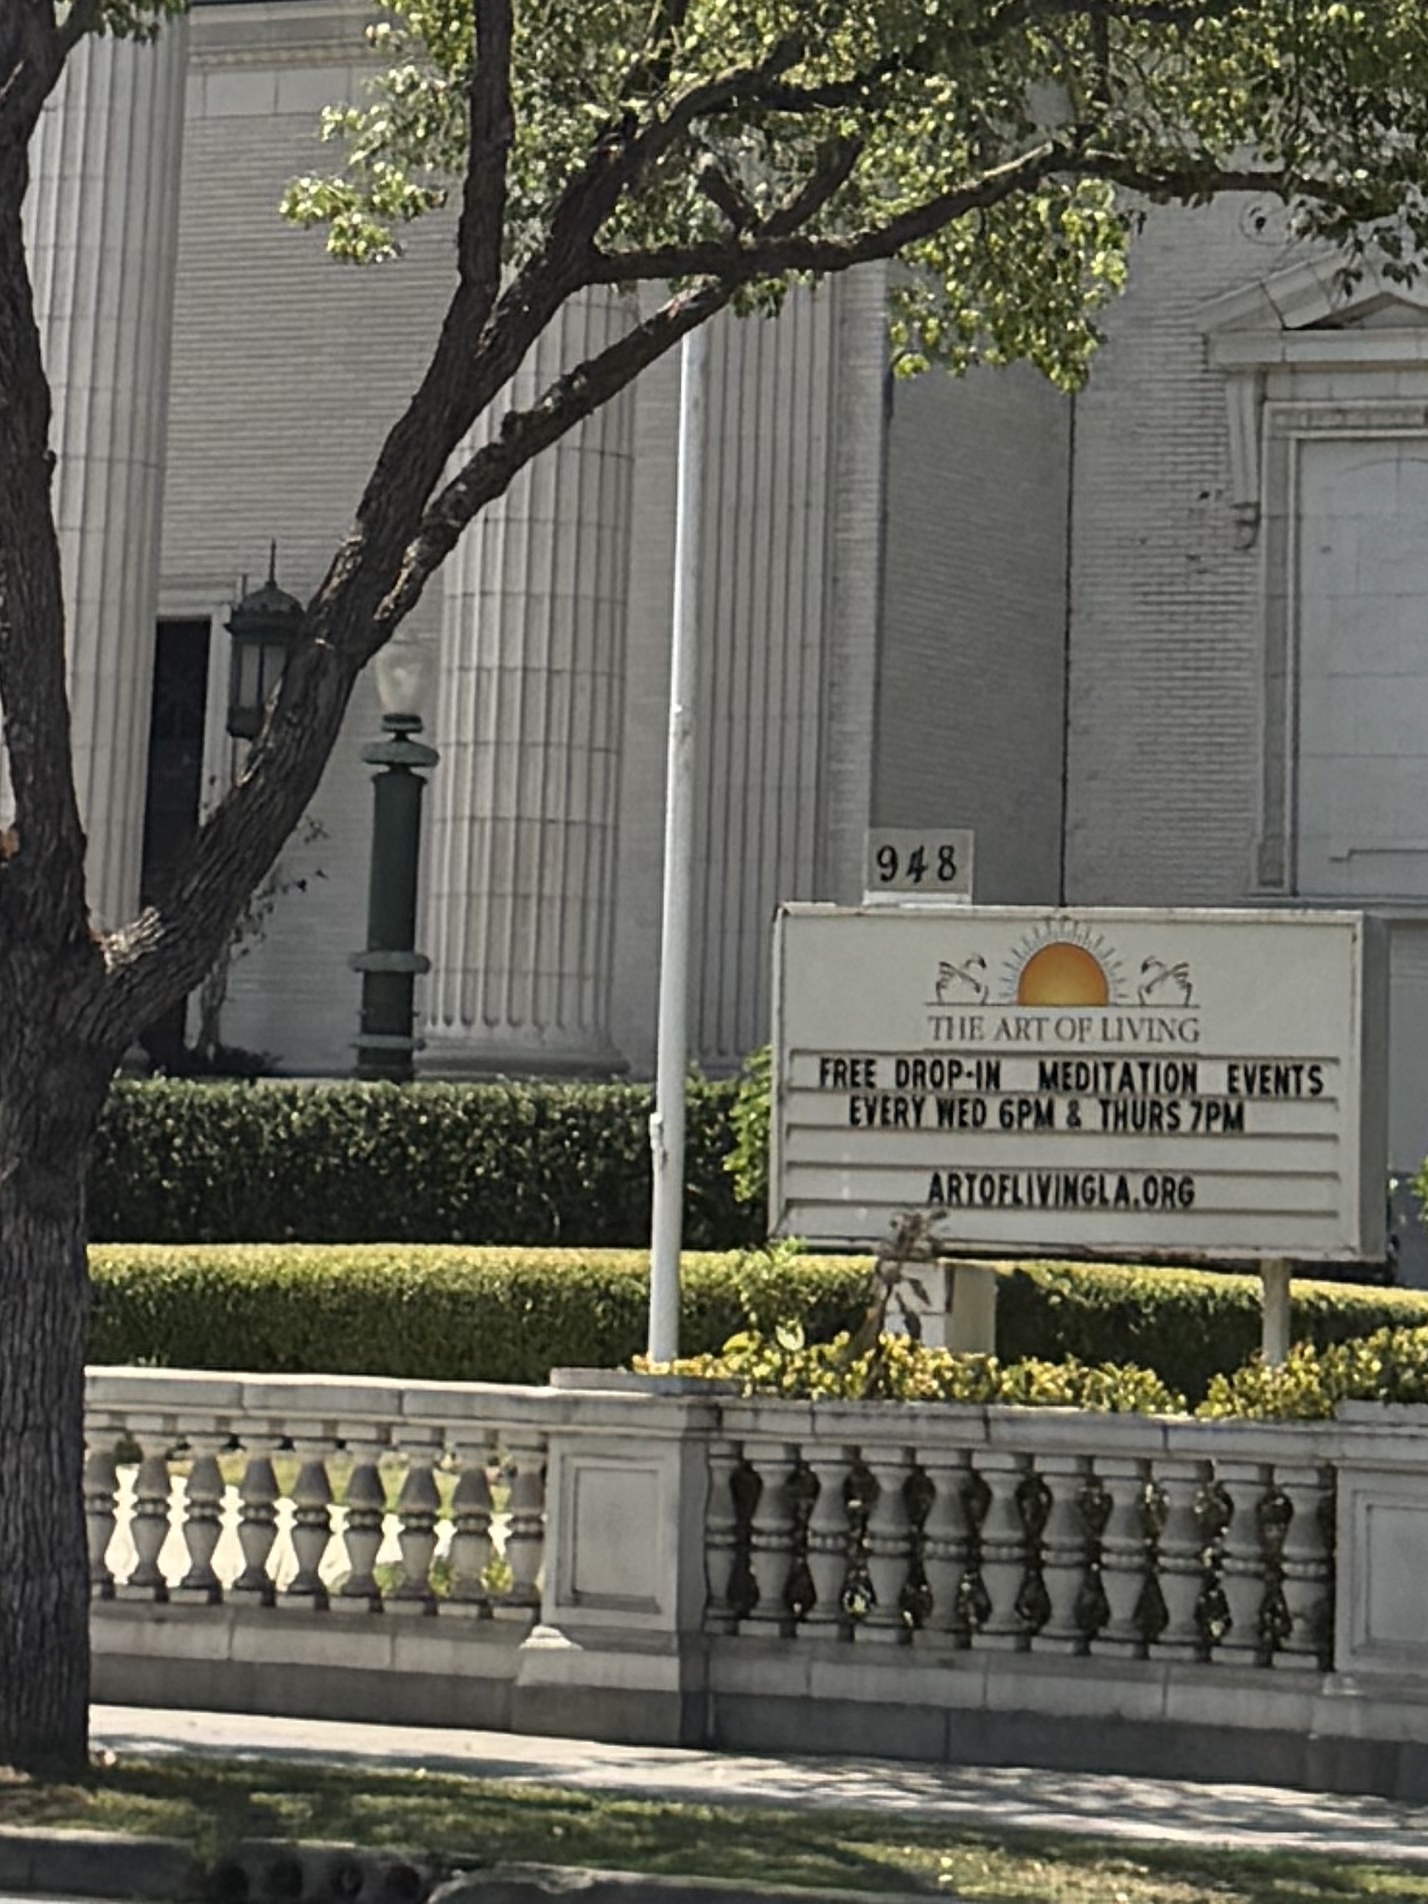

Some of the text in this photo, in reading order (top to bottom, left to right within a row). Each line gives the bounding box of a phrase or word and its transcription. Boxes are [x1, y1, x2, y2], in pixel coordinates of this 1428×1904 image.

[876, 844, 957, 883] 948
[928, 1015, 1200, 1044] THE ART OF LIVING
[819, 1057, 1324, 1094] FREE DROP-IN MEDITATION EVENTS
[849, 1096, 1245, 1132] EVERY WED 6PM & THURS 7PM
[928, 1172, 1195, 1208] ARTOFLIVINGLA.ORG
